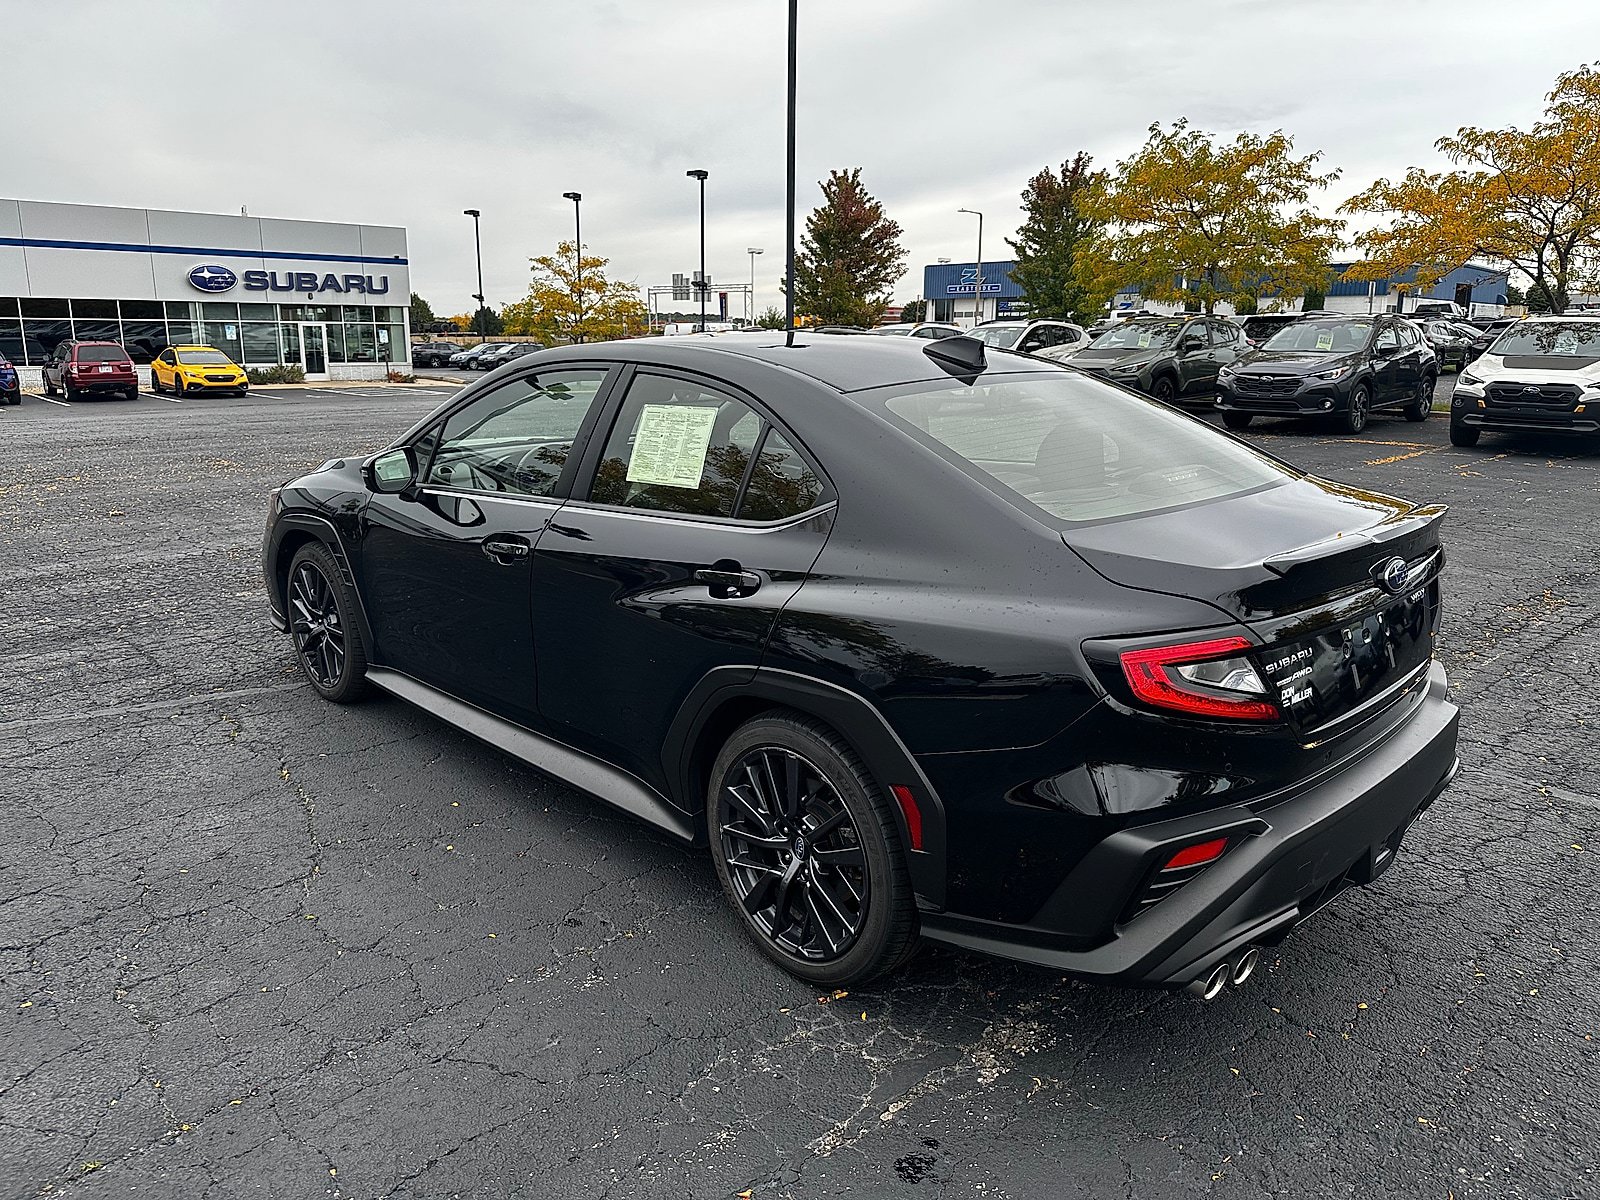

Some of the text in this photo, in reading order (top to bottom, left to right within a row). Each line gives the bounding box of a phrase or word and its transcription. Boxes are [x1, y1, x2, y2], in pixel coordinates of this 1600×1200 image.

[243, 269, 389, 295] SUBARU
[1265, 647, 1313, 675] SUBARU
[1292, 666, 1313, 682] AWD
[1281, 685, 1295, 701] DON
[1291, 686, 1313, 705] MILLER
